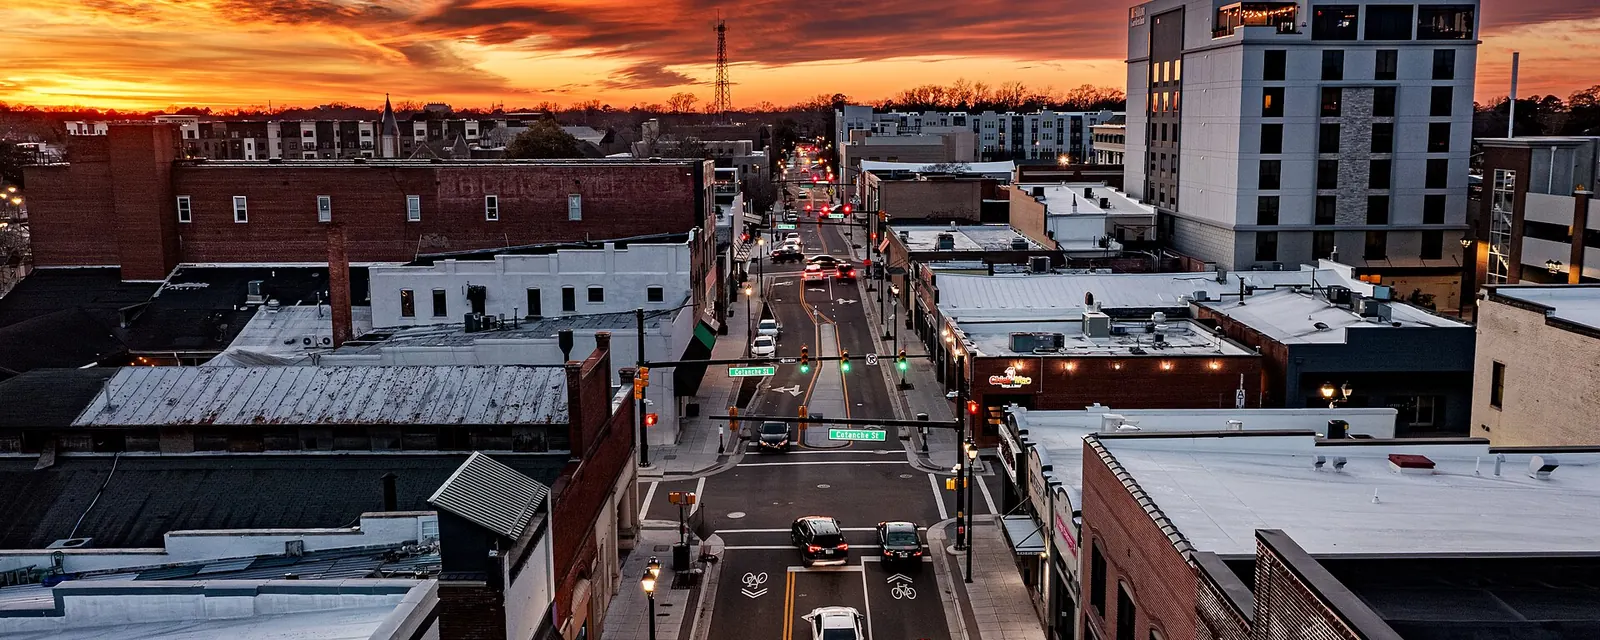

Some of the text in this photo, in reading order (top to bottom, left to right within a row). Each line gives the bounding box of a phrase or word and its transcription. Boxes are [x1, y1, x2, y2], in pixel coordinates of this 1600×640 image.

[735, 368, 762, 376] Cotanche
[836, 431, 879, 439] Cotanche St
